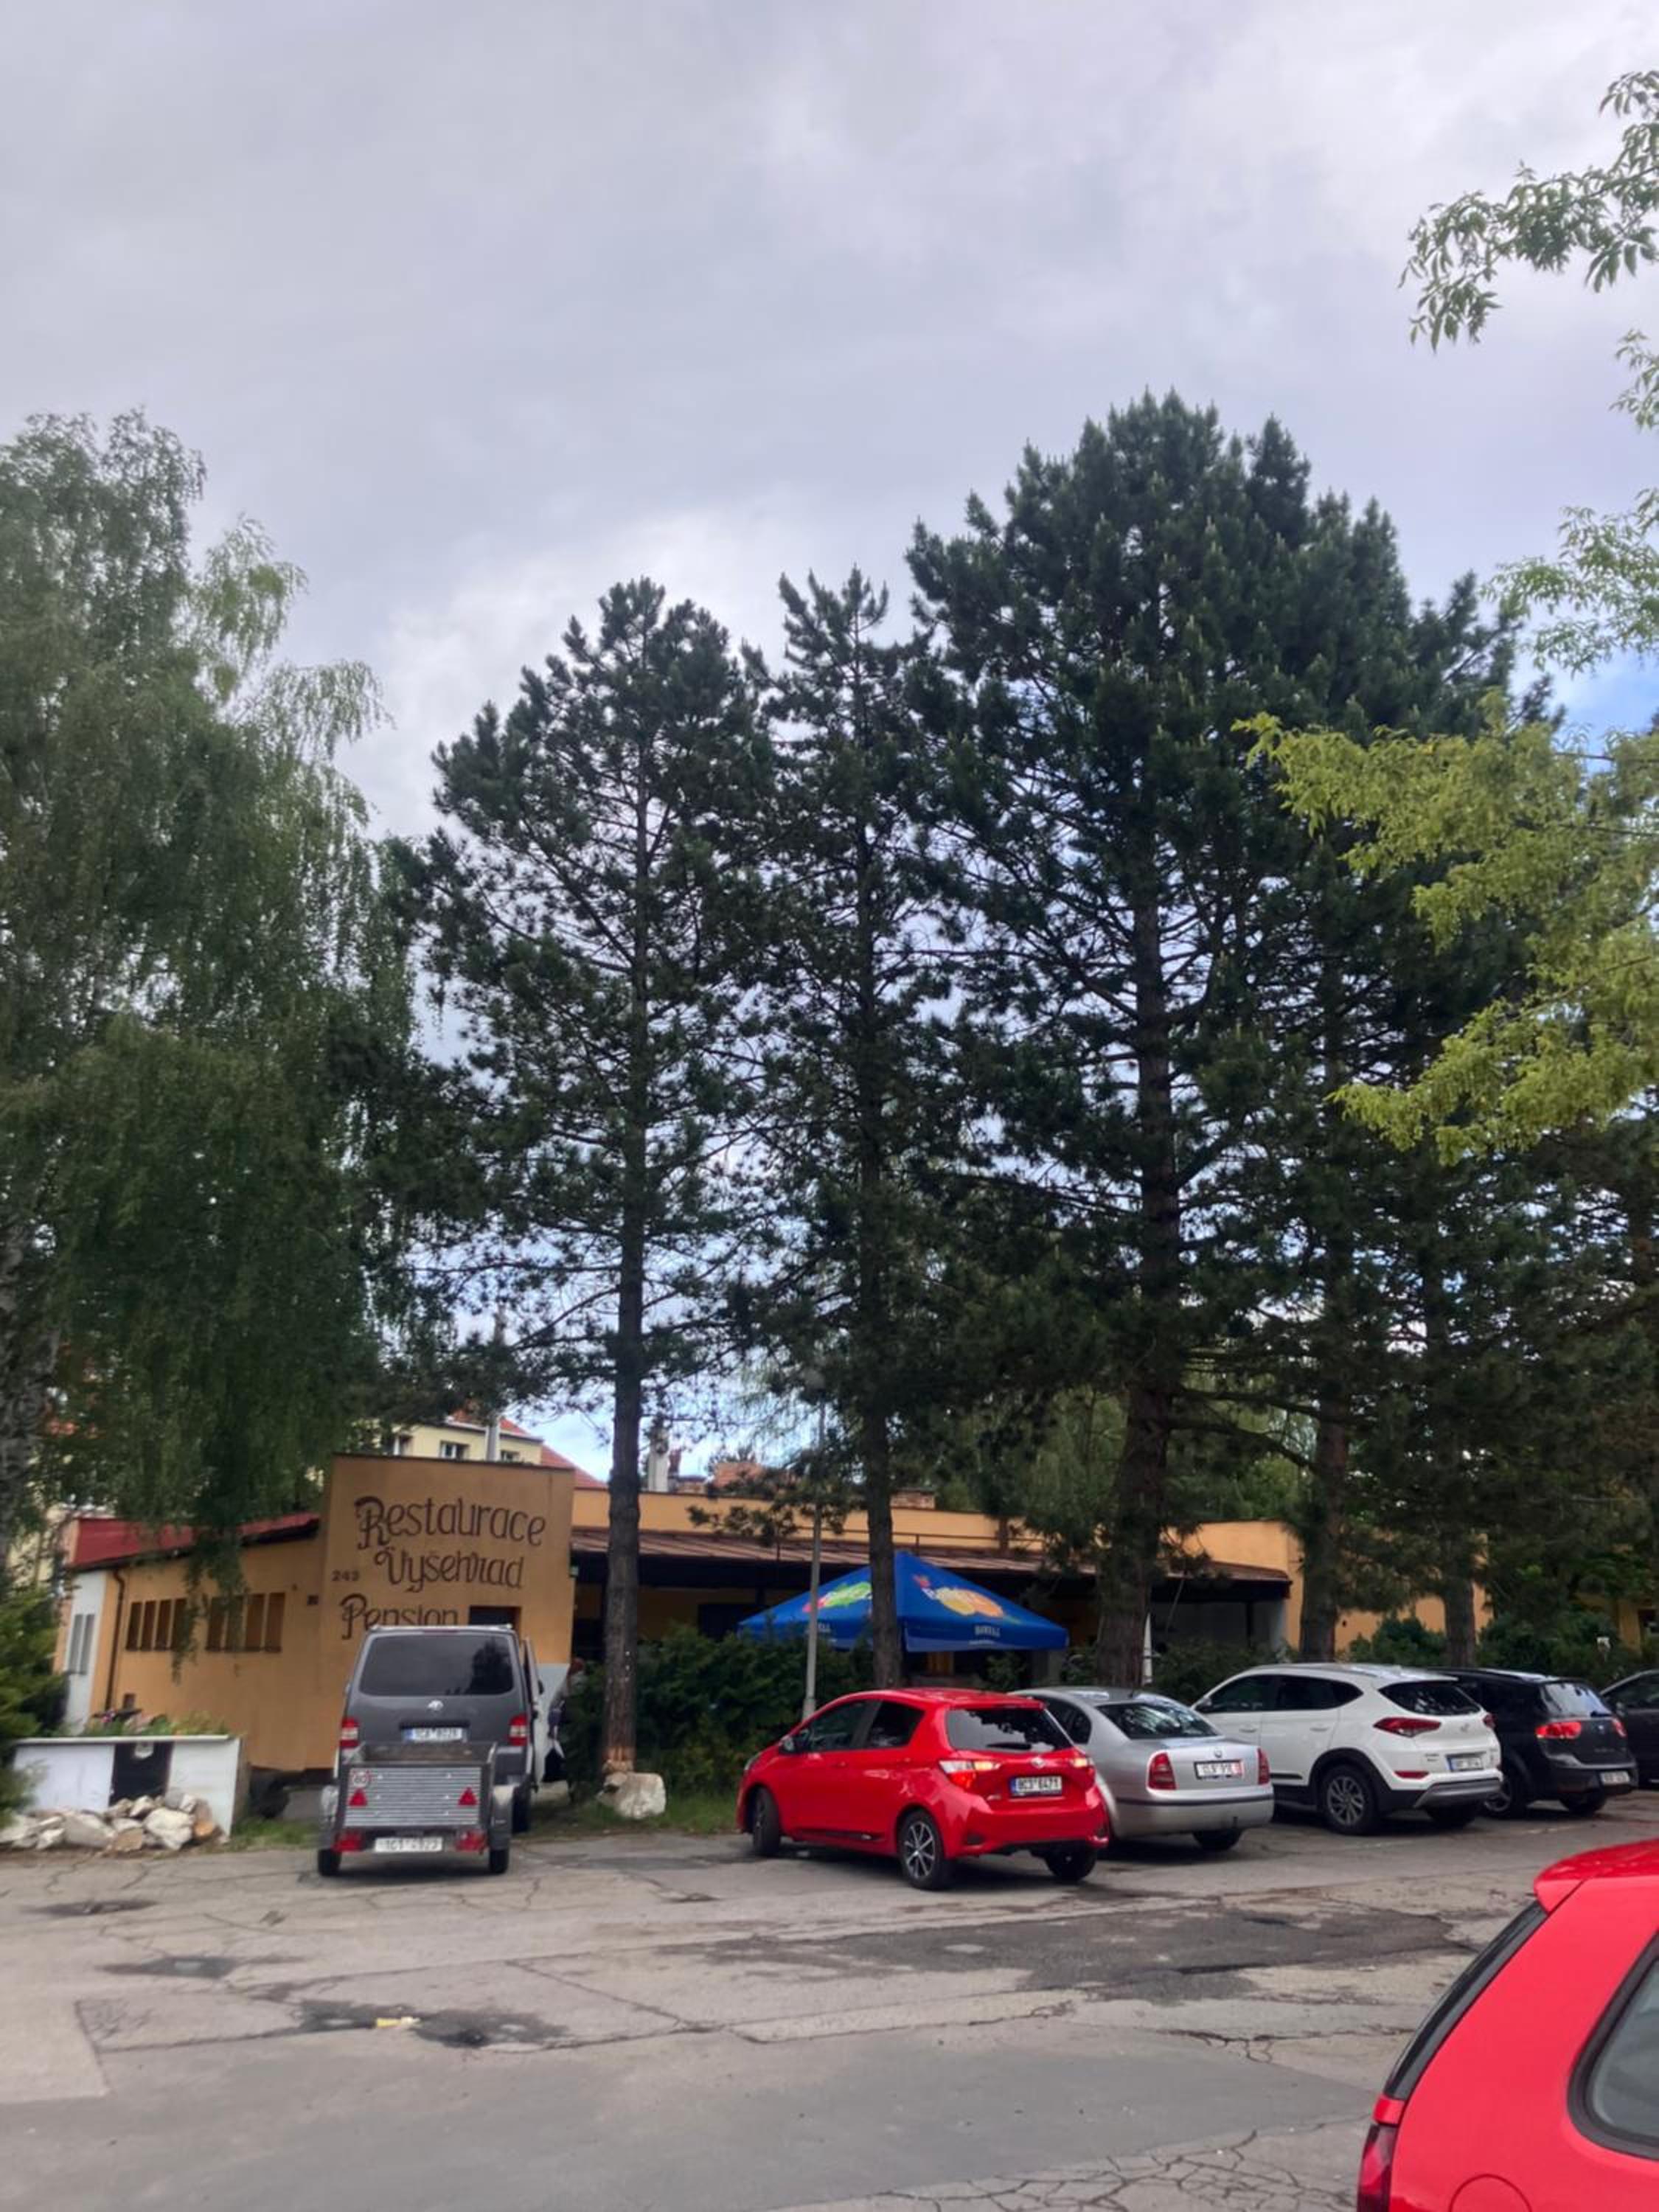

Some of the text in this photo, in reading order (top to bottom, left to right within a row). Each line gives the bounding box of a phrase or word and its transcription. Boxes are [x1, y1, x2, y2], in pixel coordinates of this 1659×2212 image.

[355, 1495, 546, 1550] Restaurace
[374, 1547, 523, 1593] Vyšehrad
[340, 1593, 458, 1640] Pension
